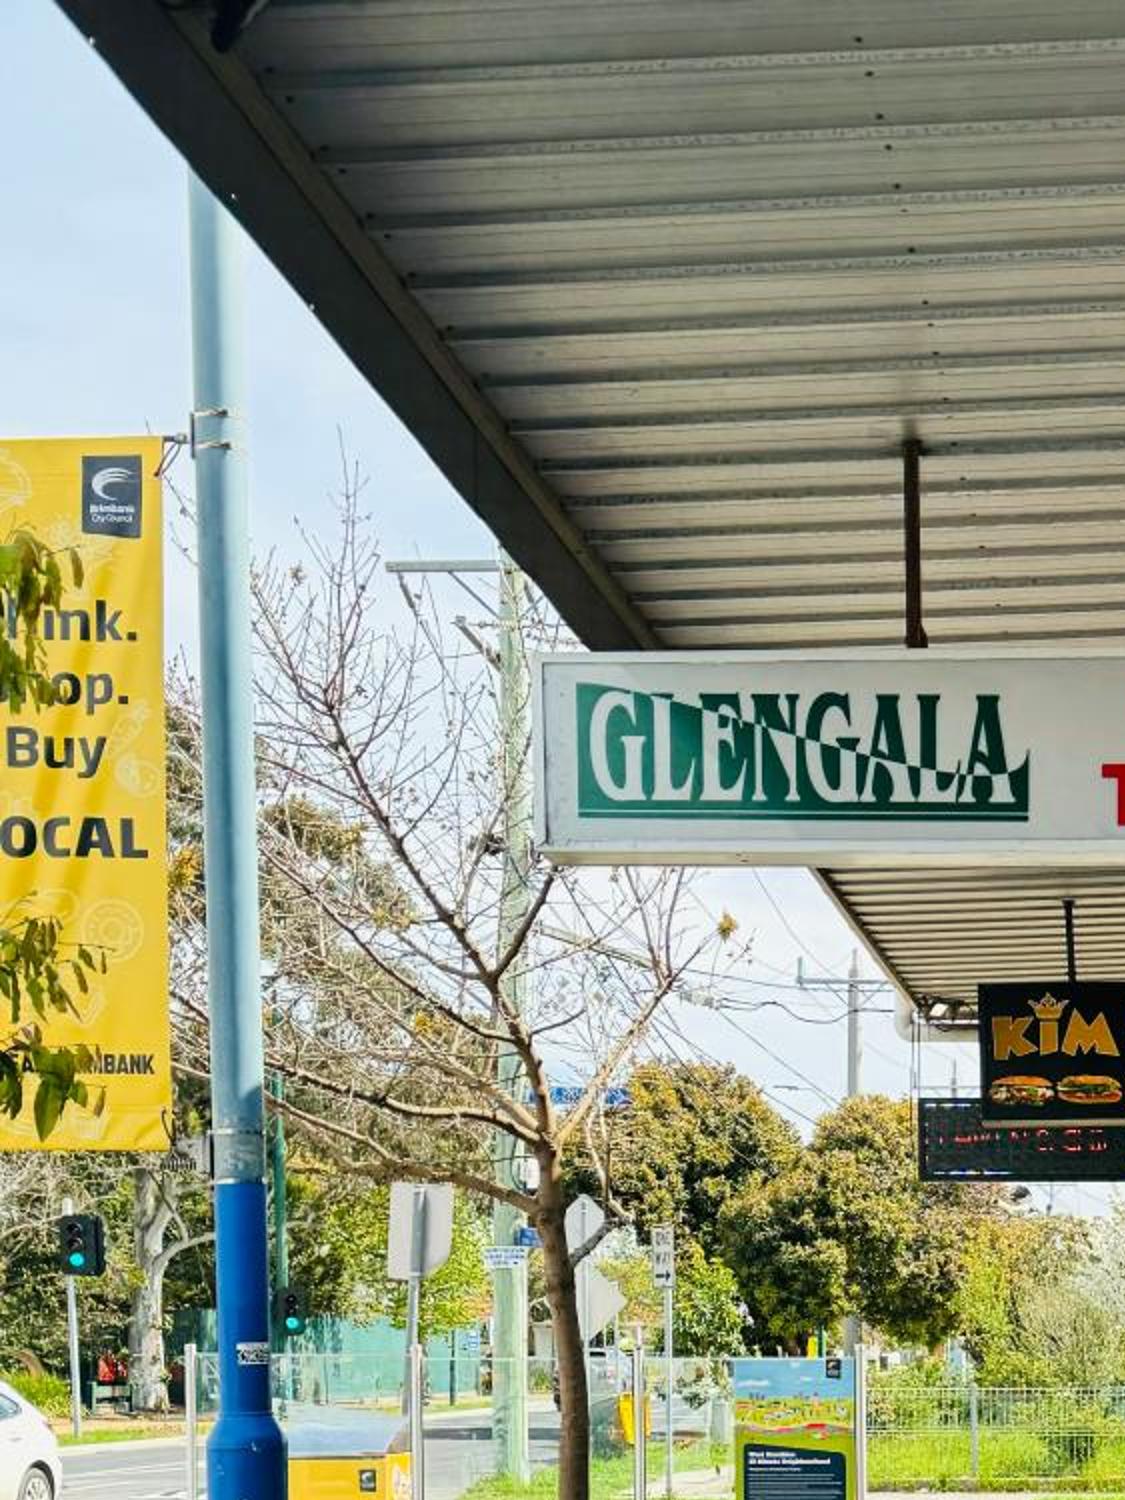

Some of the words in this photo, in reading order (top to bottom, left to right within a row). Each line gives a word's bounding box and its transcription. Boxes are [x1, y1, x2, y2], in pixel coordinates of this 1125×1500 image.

[7, 726, 107, 778] Buy
[589, 691, 1017, 803] GLENGALA
[991, 1007, 1121, 1061] KIM
